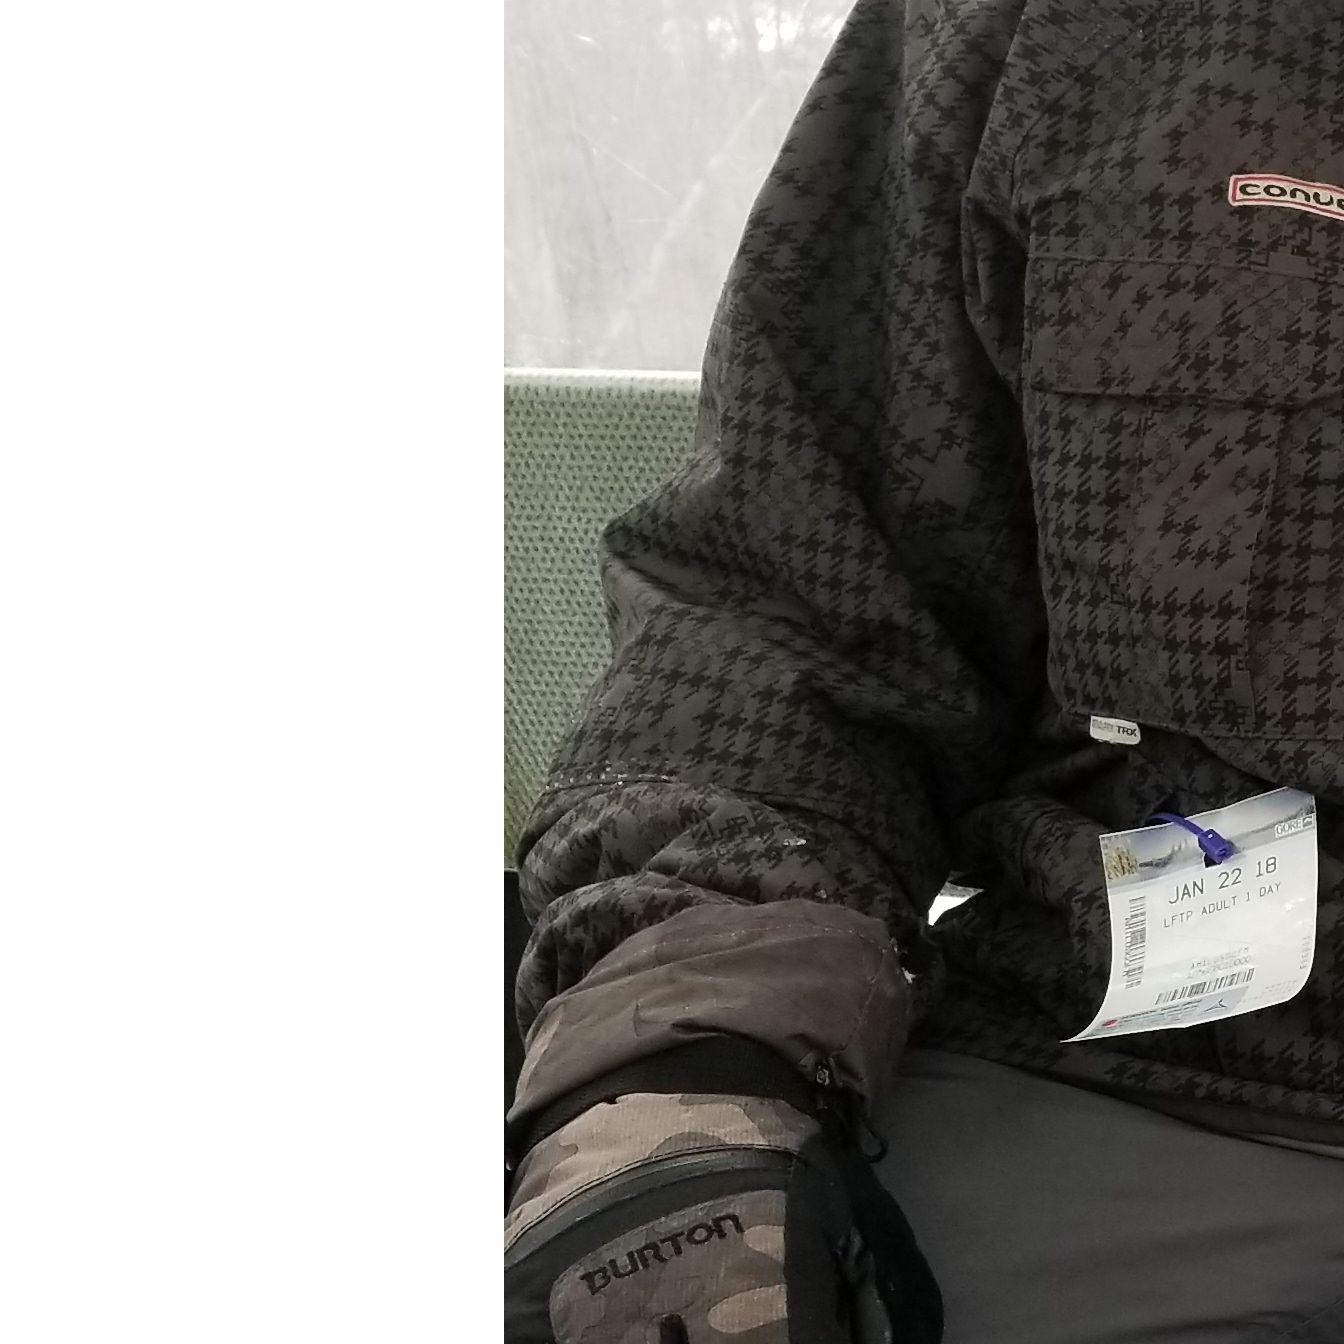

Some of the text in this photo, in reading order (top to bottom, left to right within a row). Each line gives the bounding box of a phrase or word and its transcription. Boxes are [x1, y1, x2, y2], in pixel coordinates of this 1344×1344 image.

[1163, 910, 1193, 928] LFTP
[1201, 895, 1237, 915] ADULT
[1259, 881, 1282, 898] DAY
[1168, 856, 1277, 905] JAN 22 18
[579, 1213, 745, 1296] BURTON
